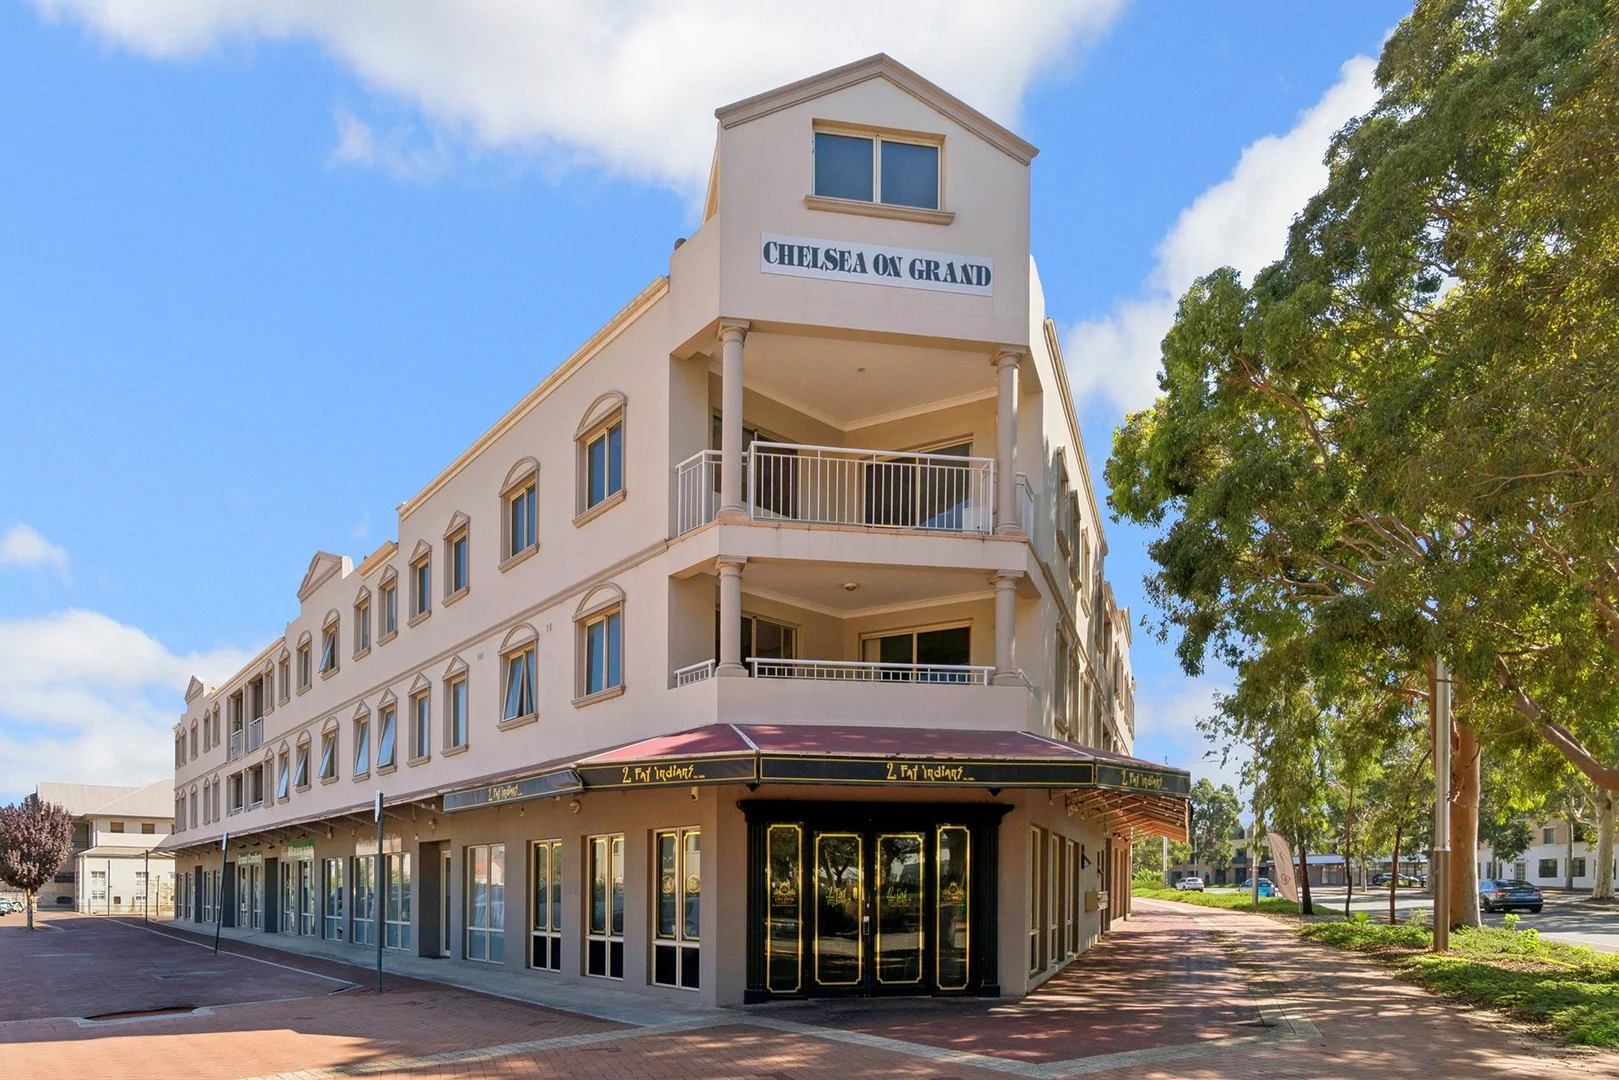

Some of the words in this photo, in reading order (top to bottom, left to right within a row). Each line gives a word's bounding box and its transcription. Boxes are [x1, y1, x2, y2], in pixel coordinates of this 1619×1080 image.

[763, 241, 868, 274] CHELSEA
[873, 253, 903, 277] ON
[908, 258, 992, 287] GRAND
[622, 766, 632, 783] 2
[886, 762, 897, 780] 2
[1121, 769, 1128, 786] 2
[488, 787, 493, 801] 2
